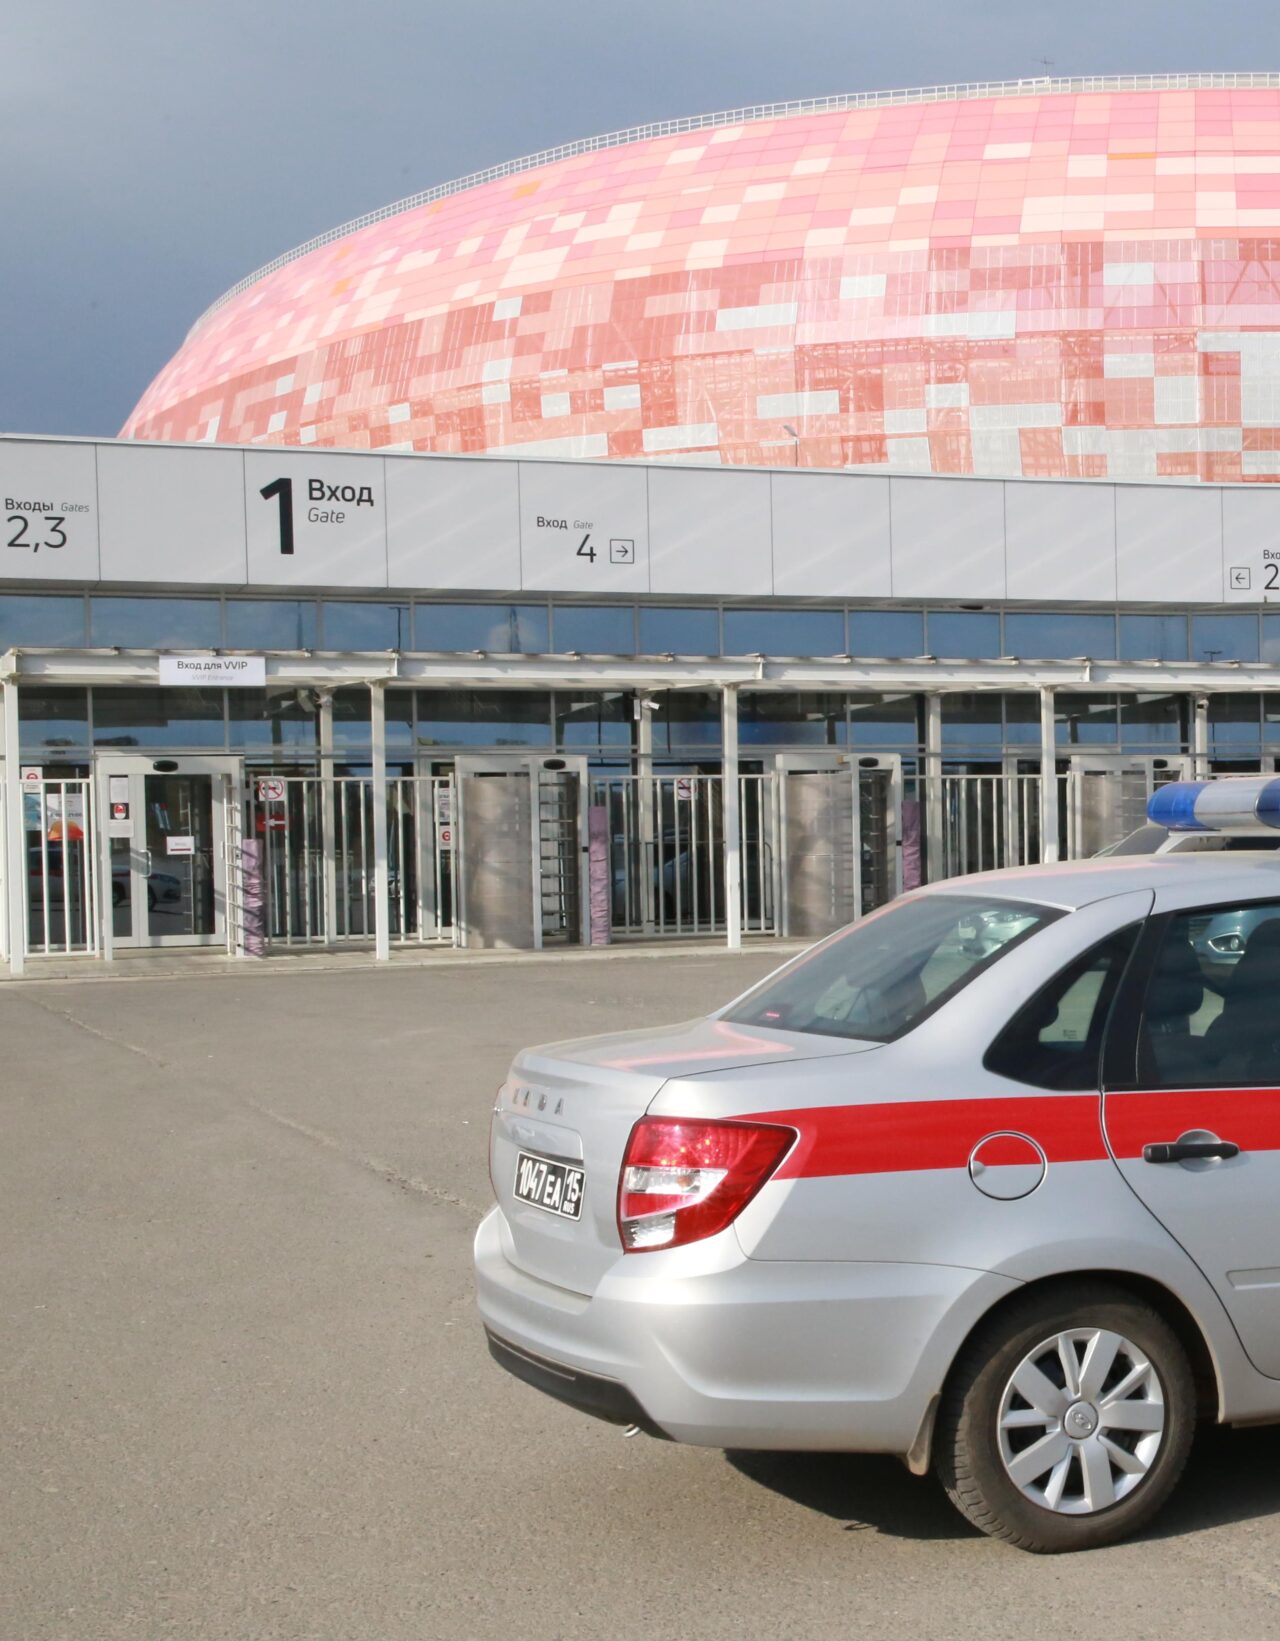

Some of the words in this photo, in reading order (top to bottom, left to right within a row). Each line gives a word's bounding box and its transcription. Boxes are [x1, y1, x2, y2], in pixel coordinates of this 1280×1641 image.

[308, 479, 374, 507] Вход
[5, 498, 53, 513] Входы
[61, 502, 90, 513] Gates
[260, 478, 294, 555] 1
[308, 507, 345, 523] Gate
[536, 516, 568, 530] Вход
[573, 520, 594, 529] Gate
[7, 515, 67, 553] 2,3
[576, 534, 597, 563] 4
[177, 660, 202, 670] Вход
[203, 662, 222, 670] для
[223, 661, 248, 669] VVIP
[562, 1200, 576, 1214] RUS
